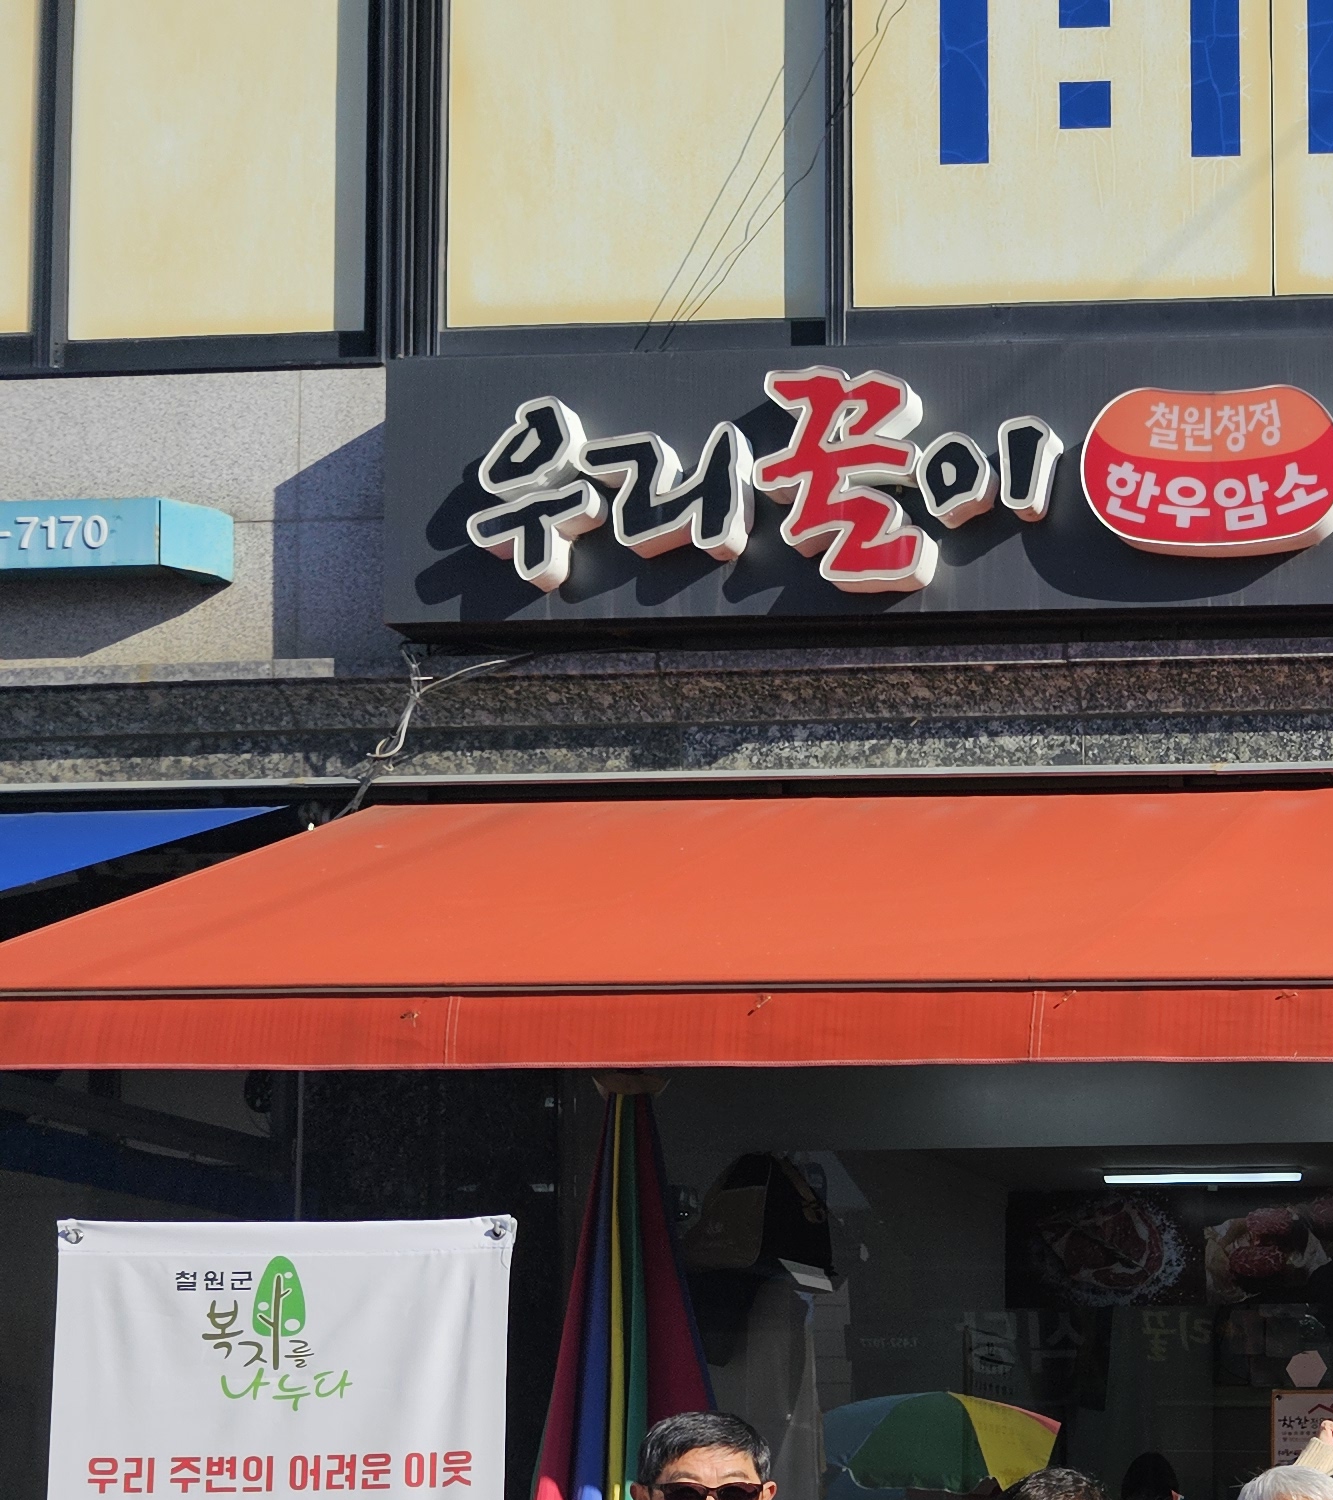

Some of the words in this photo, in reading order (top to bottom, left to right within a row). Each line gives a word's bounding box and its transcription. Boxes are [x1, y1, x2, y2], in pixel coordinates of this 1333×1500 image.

[1144, 400, 1281, 453] 철원청정
[1104, 460, 1329, 531] 한우암소
[174, 1270, 254, 1292] 철원군
[201, 1298, 315, 1371] 복지를
[220, 1367, 353, 1412] 나누다
[87, 1456, 155, 1494] 우리
[169, 1455, 275, 1494] 주변의
[288, 1453, 392, 1492] 어려운
[403, 1450, 473, 1489] 이웃
